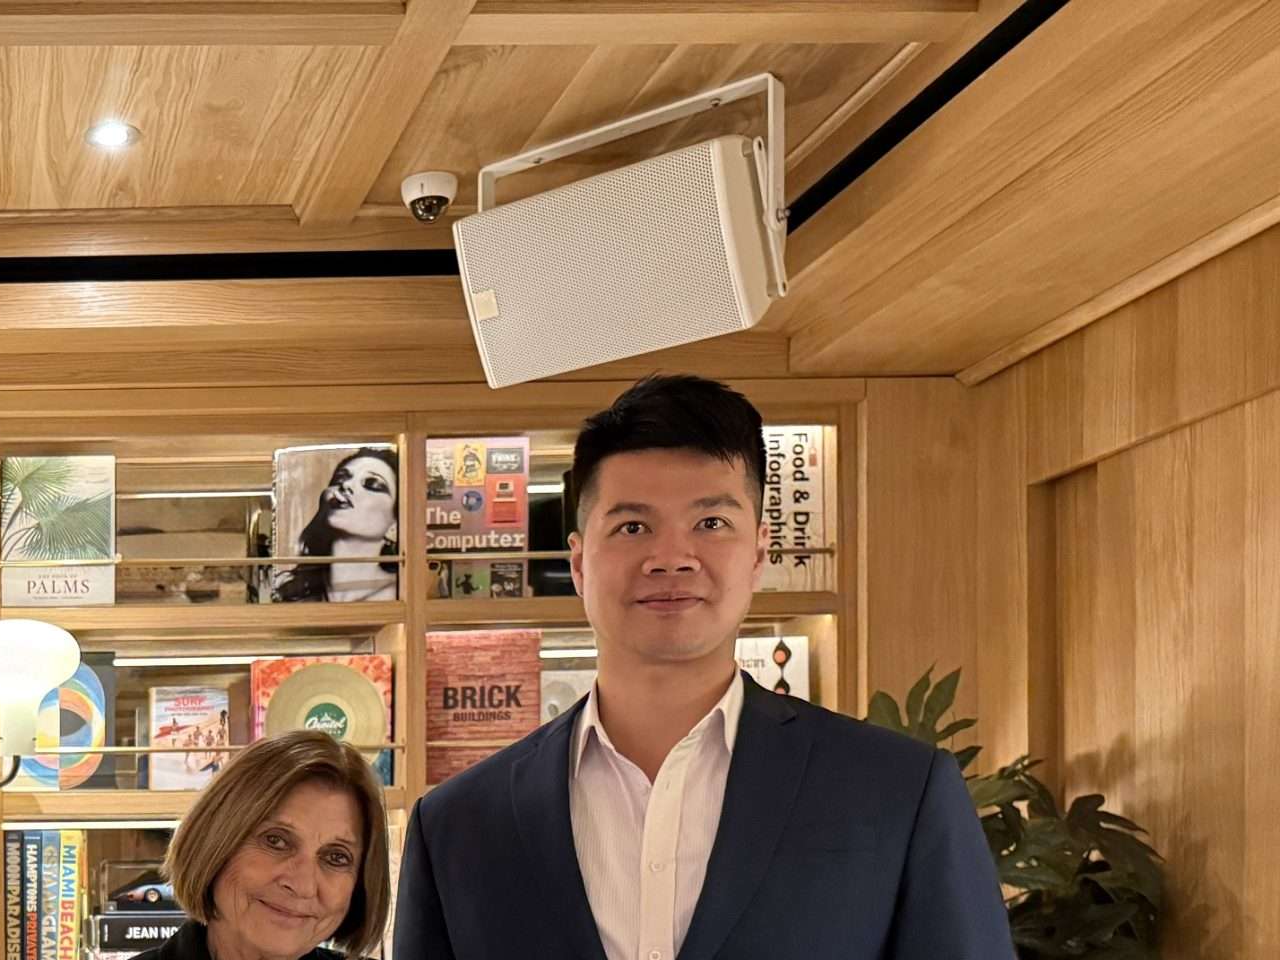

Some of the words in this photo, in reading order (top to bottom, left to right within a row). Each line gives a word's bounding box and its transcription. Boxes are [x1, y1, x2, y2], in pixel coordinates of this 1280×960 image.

[792, 433, 809, 482] Food
[765, 433, 787, 565] Infographics
[793, 489, 810, 504] &
[426, 506, 461, 525] The
[27, 579, 90, 594] PALMS
[443, 684, 522, 709] BRICK
[453, 711, 512, 721] BUILDINGS
[125, 926, 159, 939] JEAN
